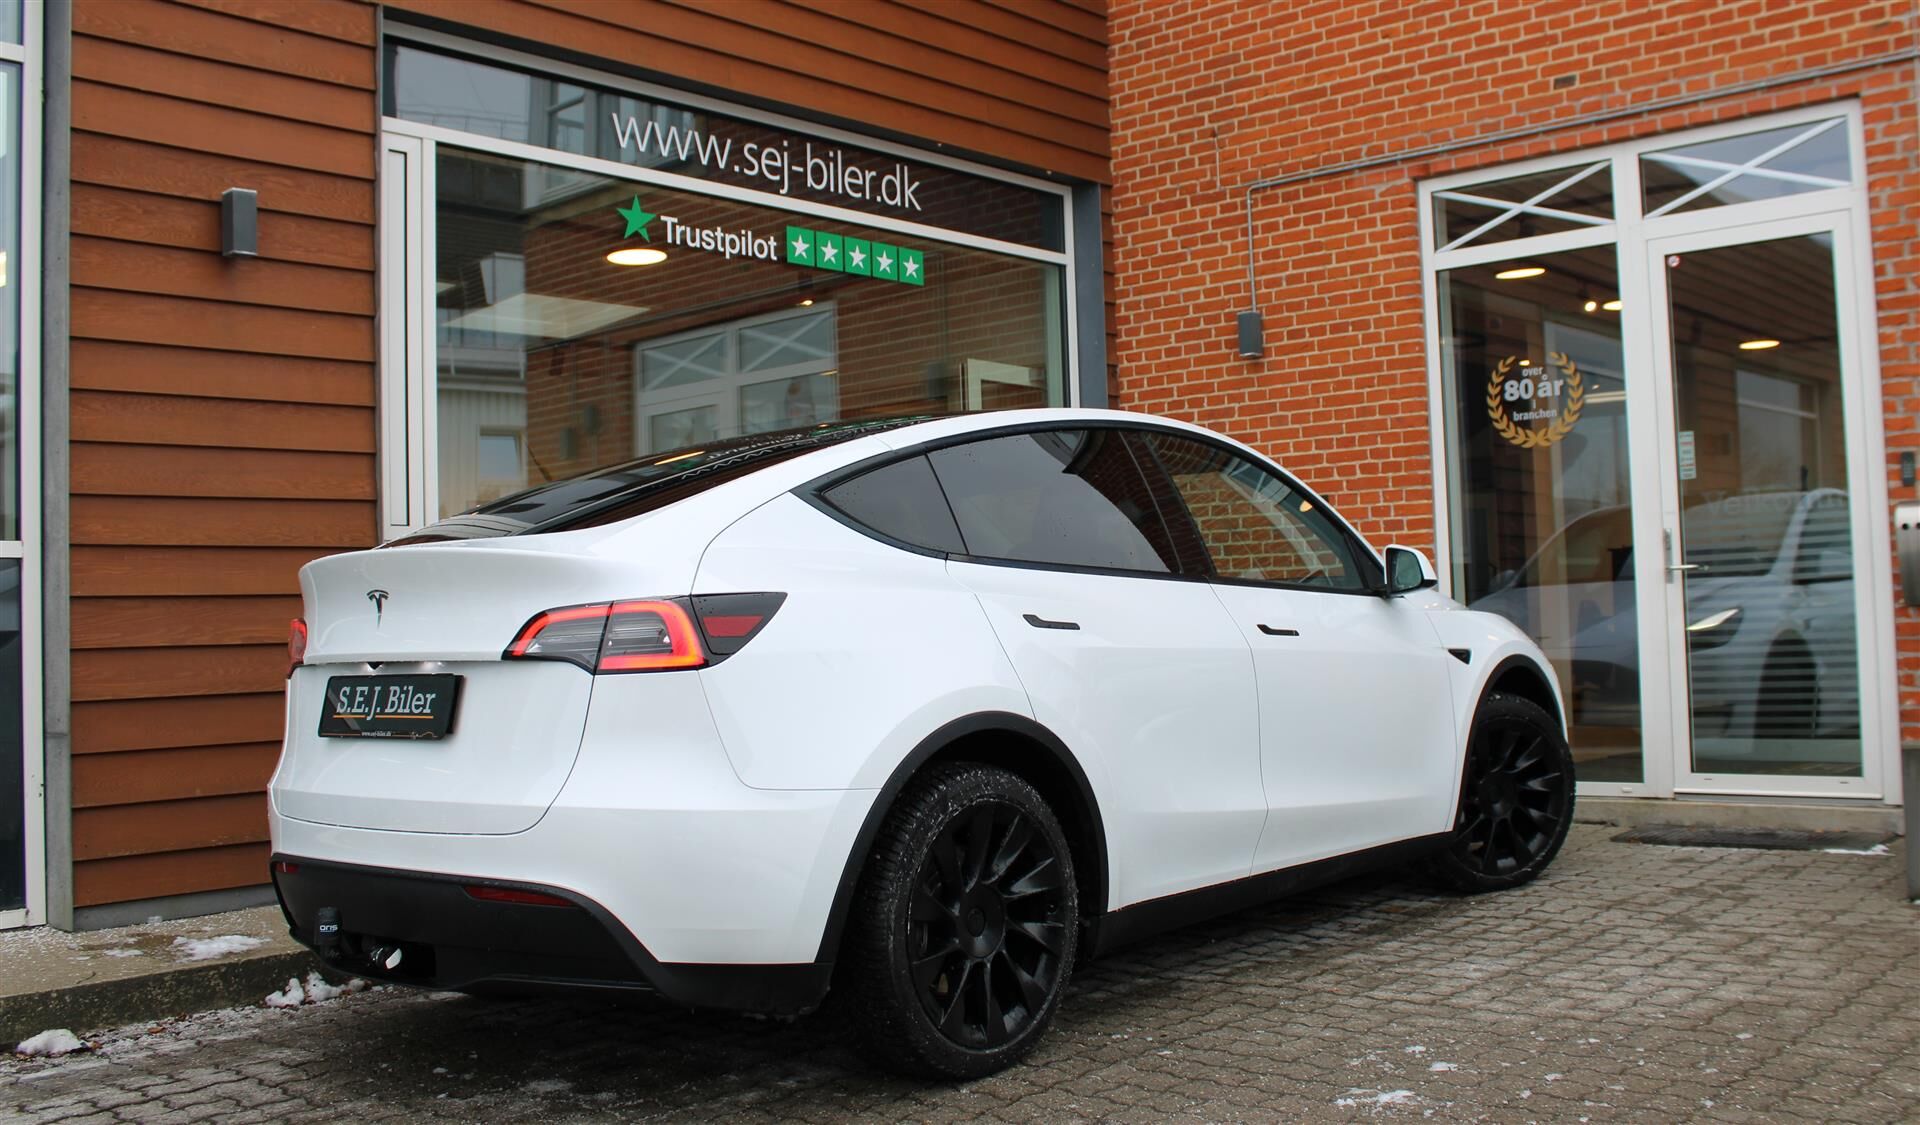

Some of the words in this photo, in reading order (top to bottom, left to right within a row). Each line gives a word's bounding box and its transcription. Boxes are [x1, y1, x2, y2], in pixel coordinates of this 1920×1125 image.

[611, 112, 922, 211] www.sej-biler.dk
[660, 215, 778, 261] Trustpilot
[1522, 366, 1544, 377] over
[1504, 379, 1535, 402] 80
[1537, 374, 1564, 399] år
[1513, 409, 1557, 421] branchen
[336, 686, 381, 721] S.E.J.
[385, 685, 436, 714] Biler
